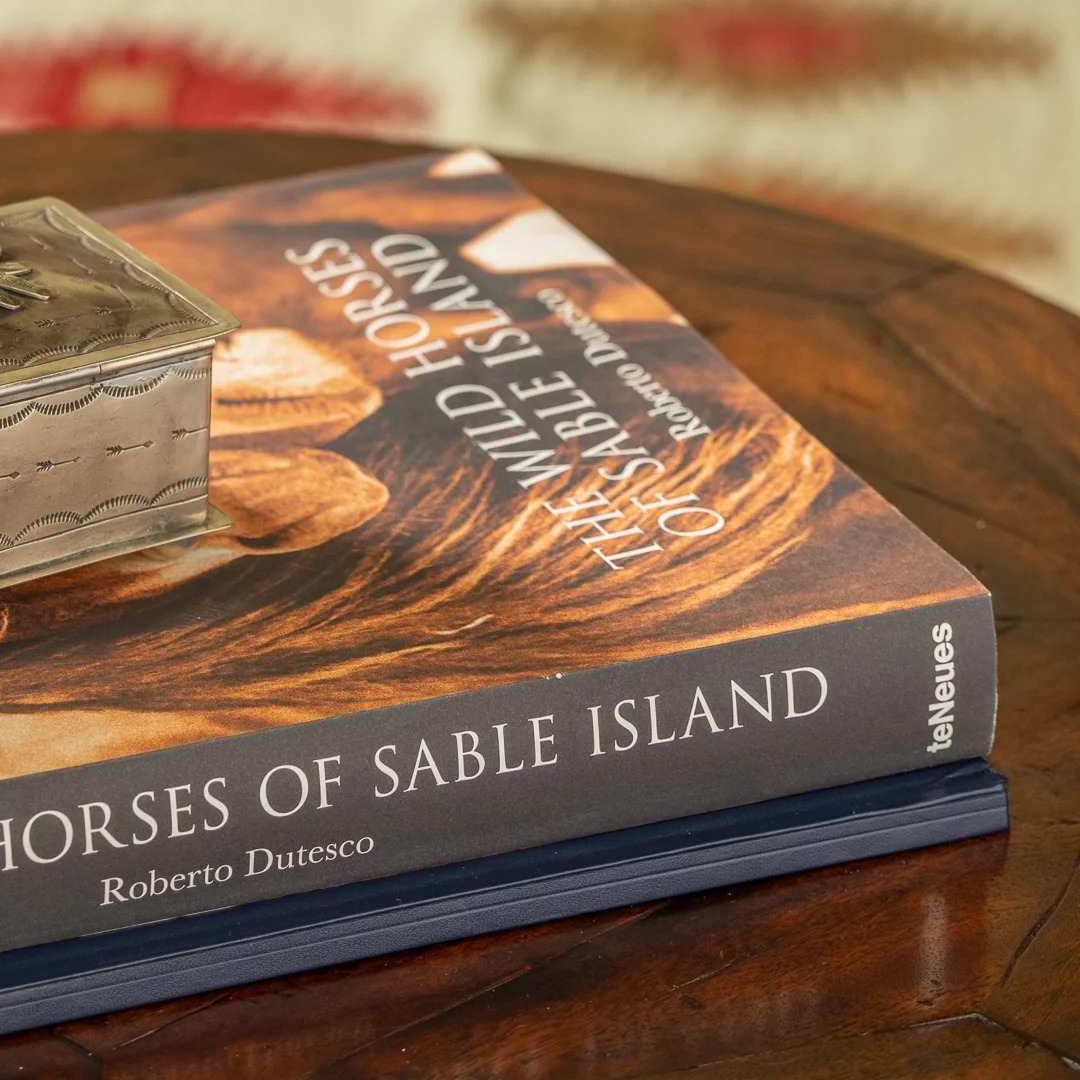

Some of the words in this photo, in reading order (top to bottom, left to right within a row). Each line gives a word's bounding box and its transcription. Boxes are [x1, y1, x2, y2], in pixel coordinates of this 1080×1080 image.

[285, 238, 464, 379] HORSES
[371, 234, 543, 369] ISLAND
[536, 288, 629, 368] Dutesco
[435, 384, 572, 489] WILD
[508, 371, 665, 481] SABLE
[616, 363, 713, 443] Roberto
[543, 489, 664, 571] THE
[630, 491, 725, 538] OF
[927, 622, 953, 754] teNeues
[259, 758, 342, 818] OF
[373, 715, 559, 798] SABLE
[588, 666, 829, 758] ISLAND
[99, 861, 233, 906] Roberto
[244, 832, 375, 877] Dutesco
